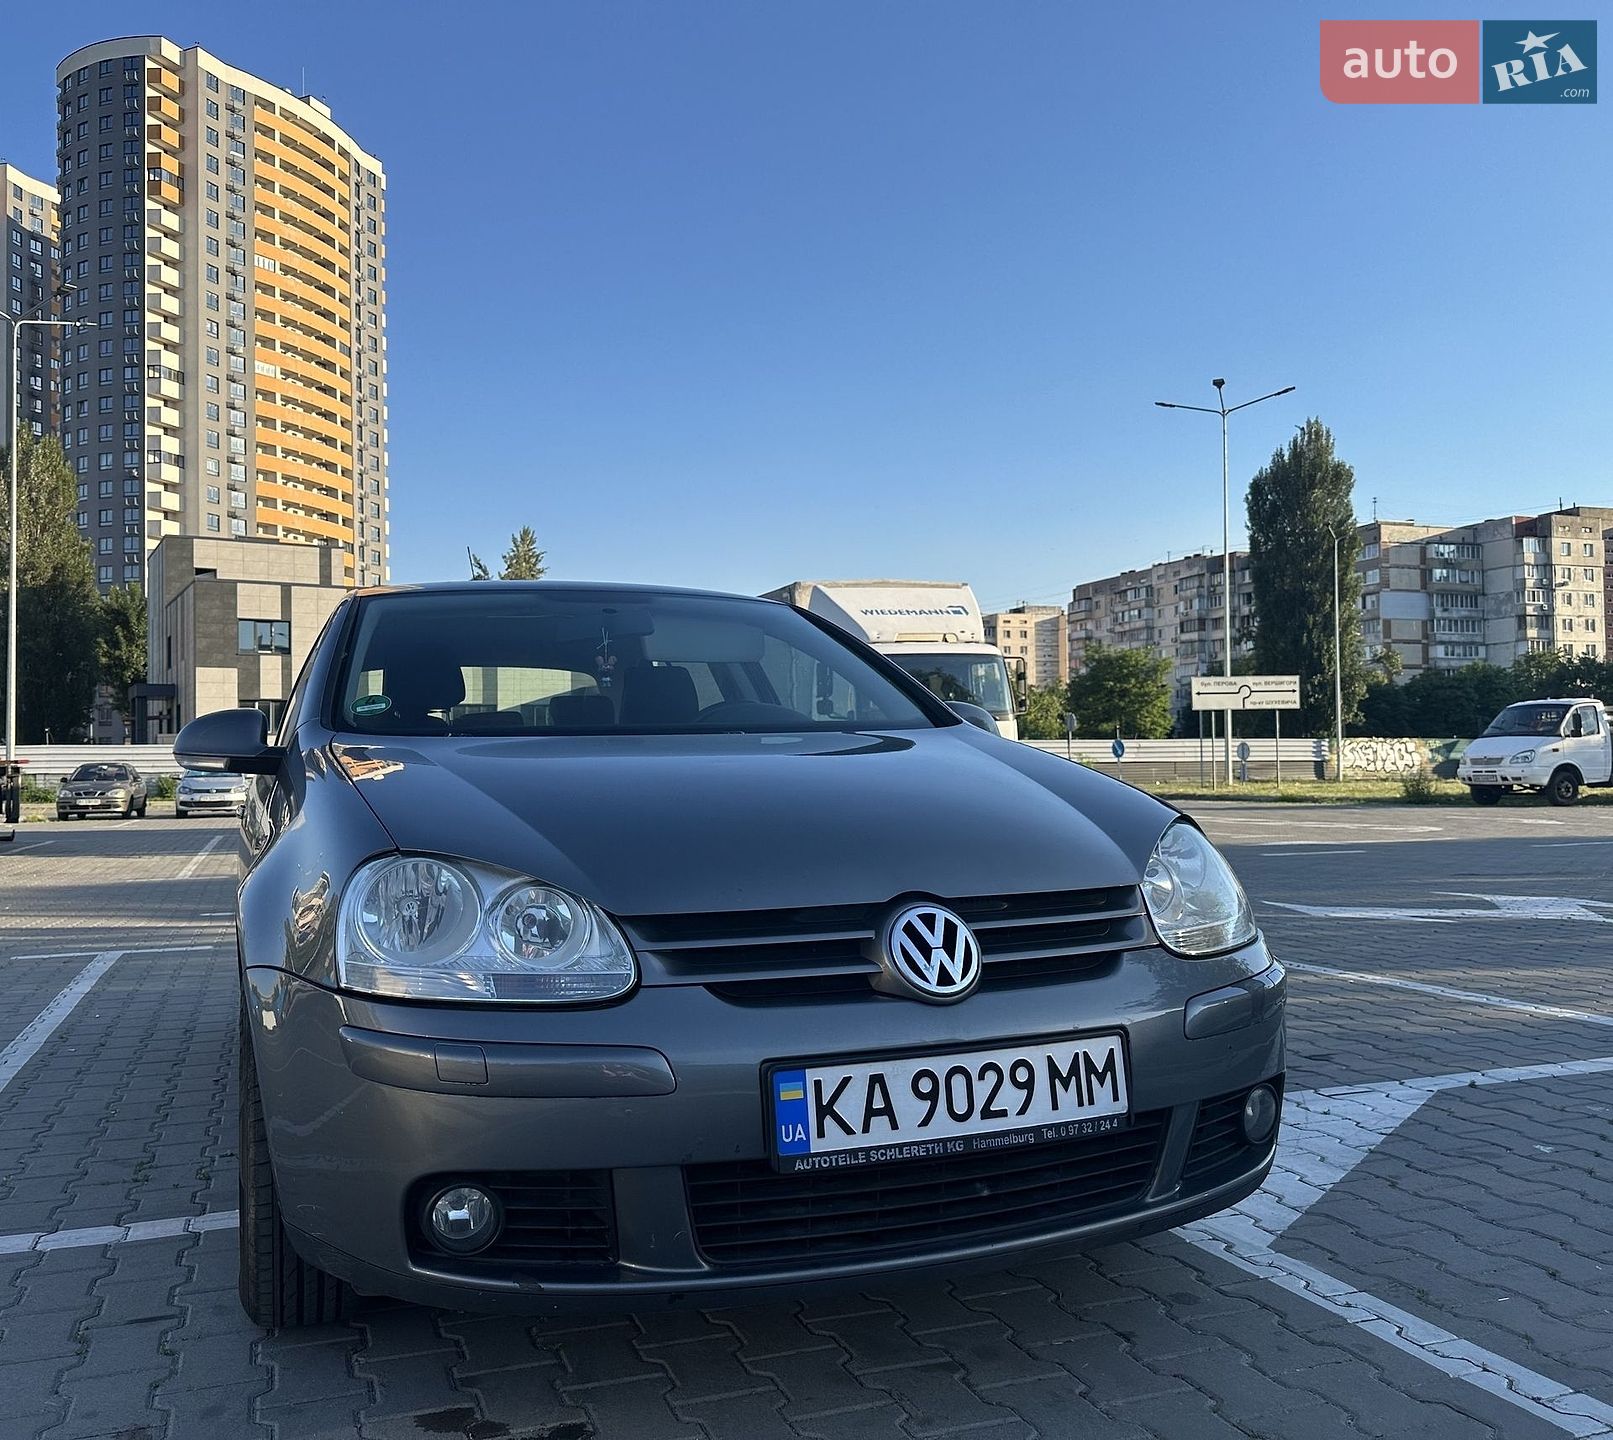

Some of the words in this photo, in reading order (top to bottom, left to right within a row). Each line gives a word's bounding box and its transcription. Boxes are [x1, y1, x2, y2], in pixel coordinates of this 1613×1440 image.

[860, 607, 951, 616] WIEDEMANN
[893, 908, 975, 991] VW
[813, 1072, 900, 1138] KA
[910, 1058, 1036, 1128] 9029
[1046, 1047, 1120, 1111] MM
[782, 1122, 807, 1143] UA
[794, 1151, 866, 1171] AUTOTEILE
[869, 1141, 944, 1162] SCHLERETH
[946, 1140, 965, 1153] KG
[973, 1133, 1035, 1149] Hammelburg
[1041, 1128, 1059, 1139] Tel.
[1060, 1127, 1066, 1136] 0
[1068, 1124, 1079, 1135] 97
[1081, 1122, 1093, 1133] 32
